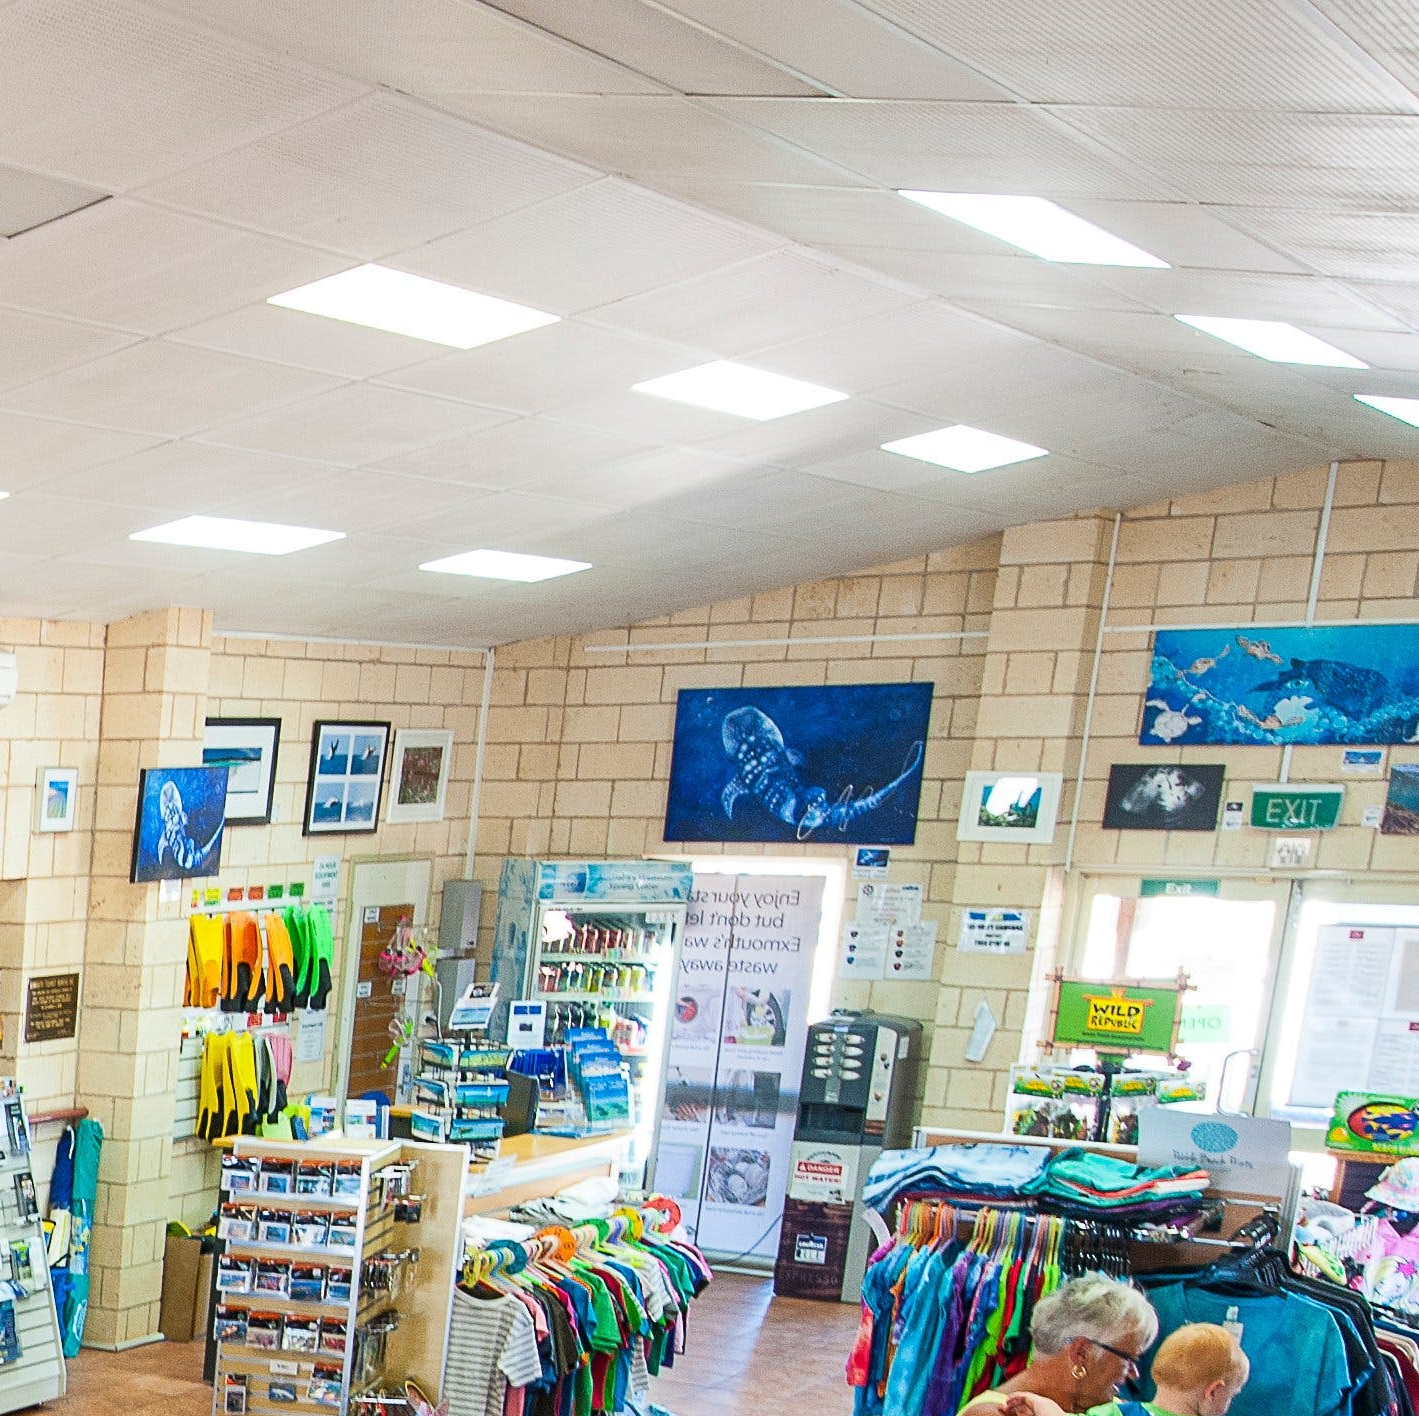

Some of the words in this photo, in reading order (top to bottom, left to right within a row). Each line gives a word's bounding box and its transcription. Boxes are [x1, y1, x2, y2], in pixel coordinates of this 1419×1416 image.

[1266, 799, 1322, 825] EXIT
[1165, 882, 1193, 894] Exit
[1093, 1003, 1141, 1017] WILD
[1091, 1015, 1138, 1030] REPUBLIC
[807, 1163, 842, 1176] DANGER
